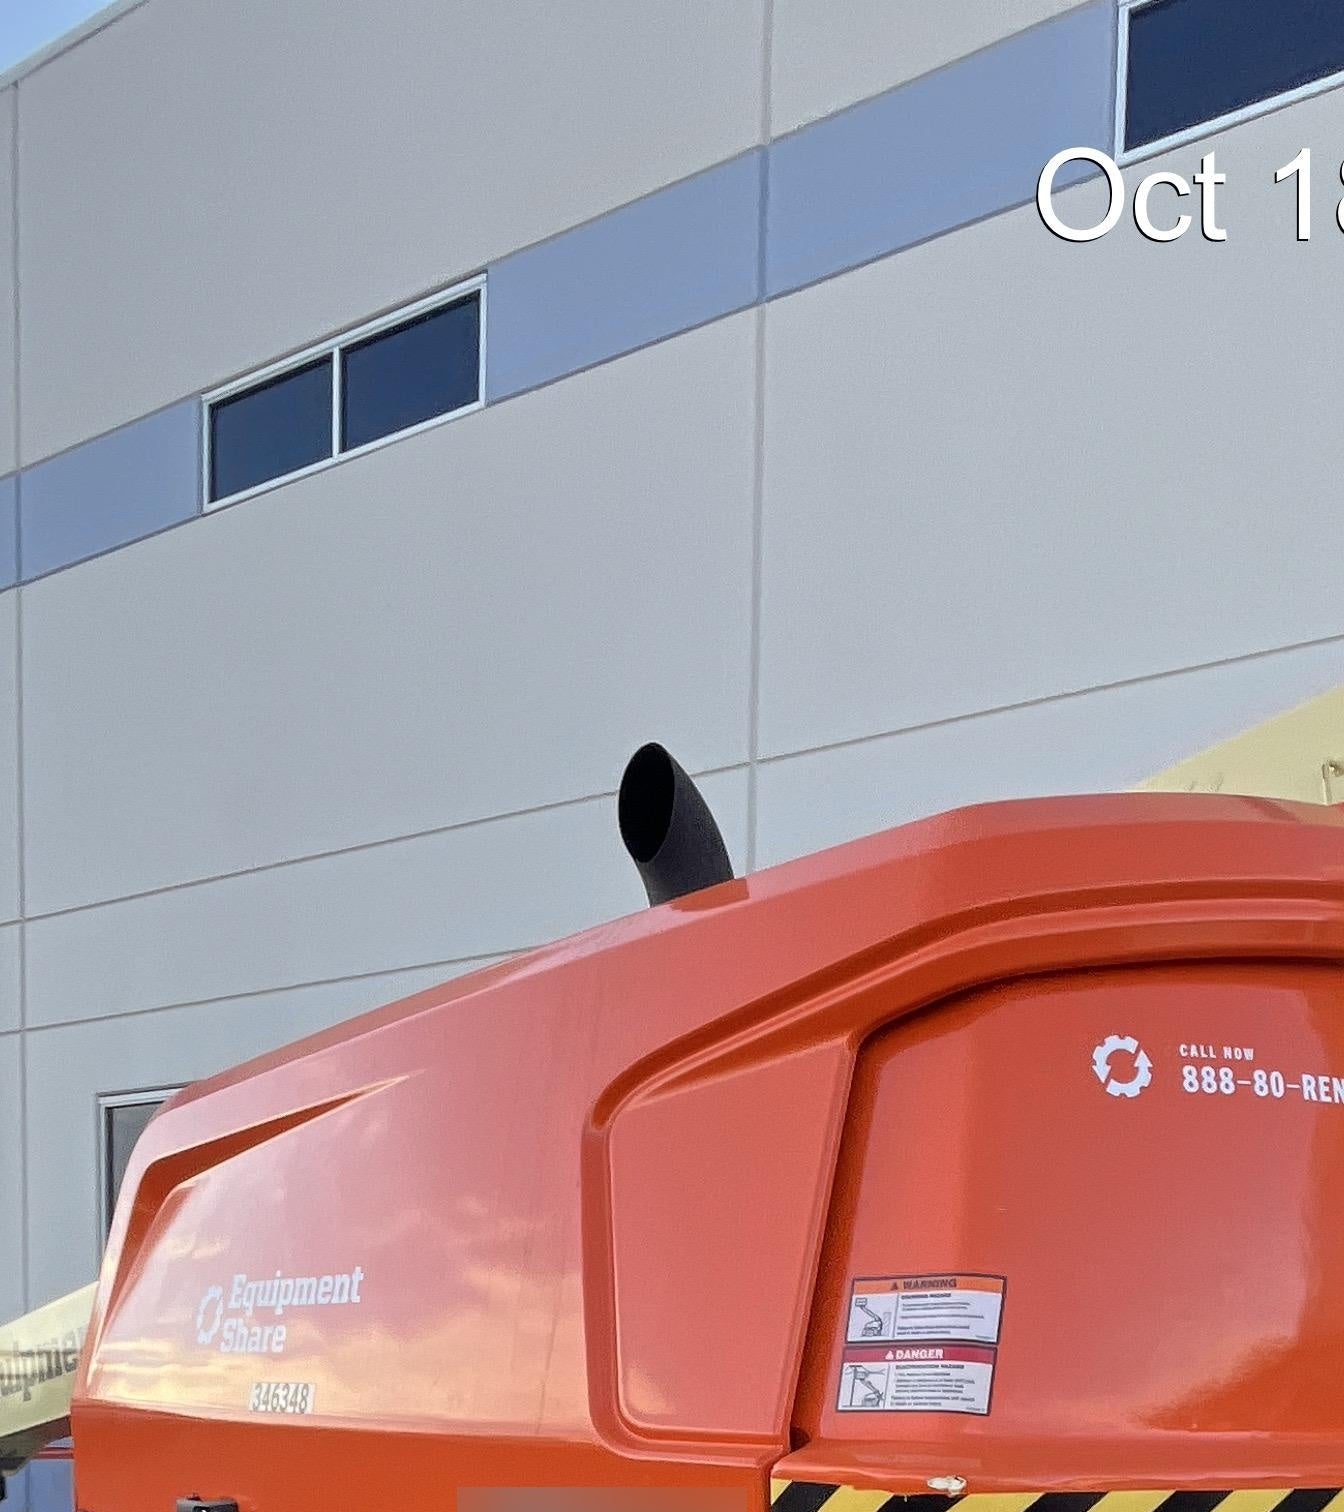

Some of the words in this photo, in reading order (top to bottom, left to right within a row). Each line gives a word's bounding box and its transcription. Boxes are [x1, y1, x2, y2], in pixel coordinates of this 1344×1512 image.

[1179, 1044, 1217, 1059] CALL
[1223, 1046, 1254, 1061] NOW
[227, 1266, 365, 1316] Equipment
[903, 1278, 957, 1290] WARNING
[220, 1318, 287, 1354] Share
[895, 1348, 944, 1360] DANGER
[252, 1382, 312, 1415] 346348
